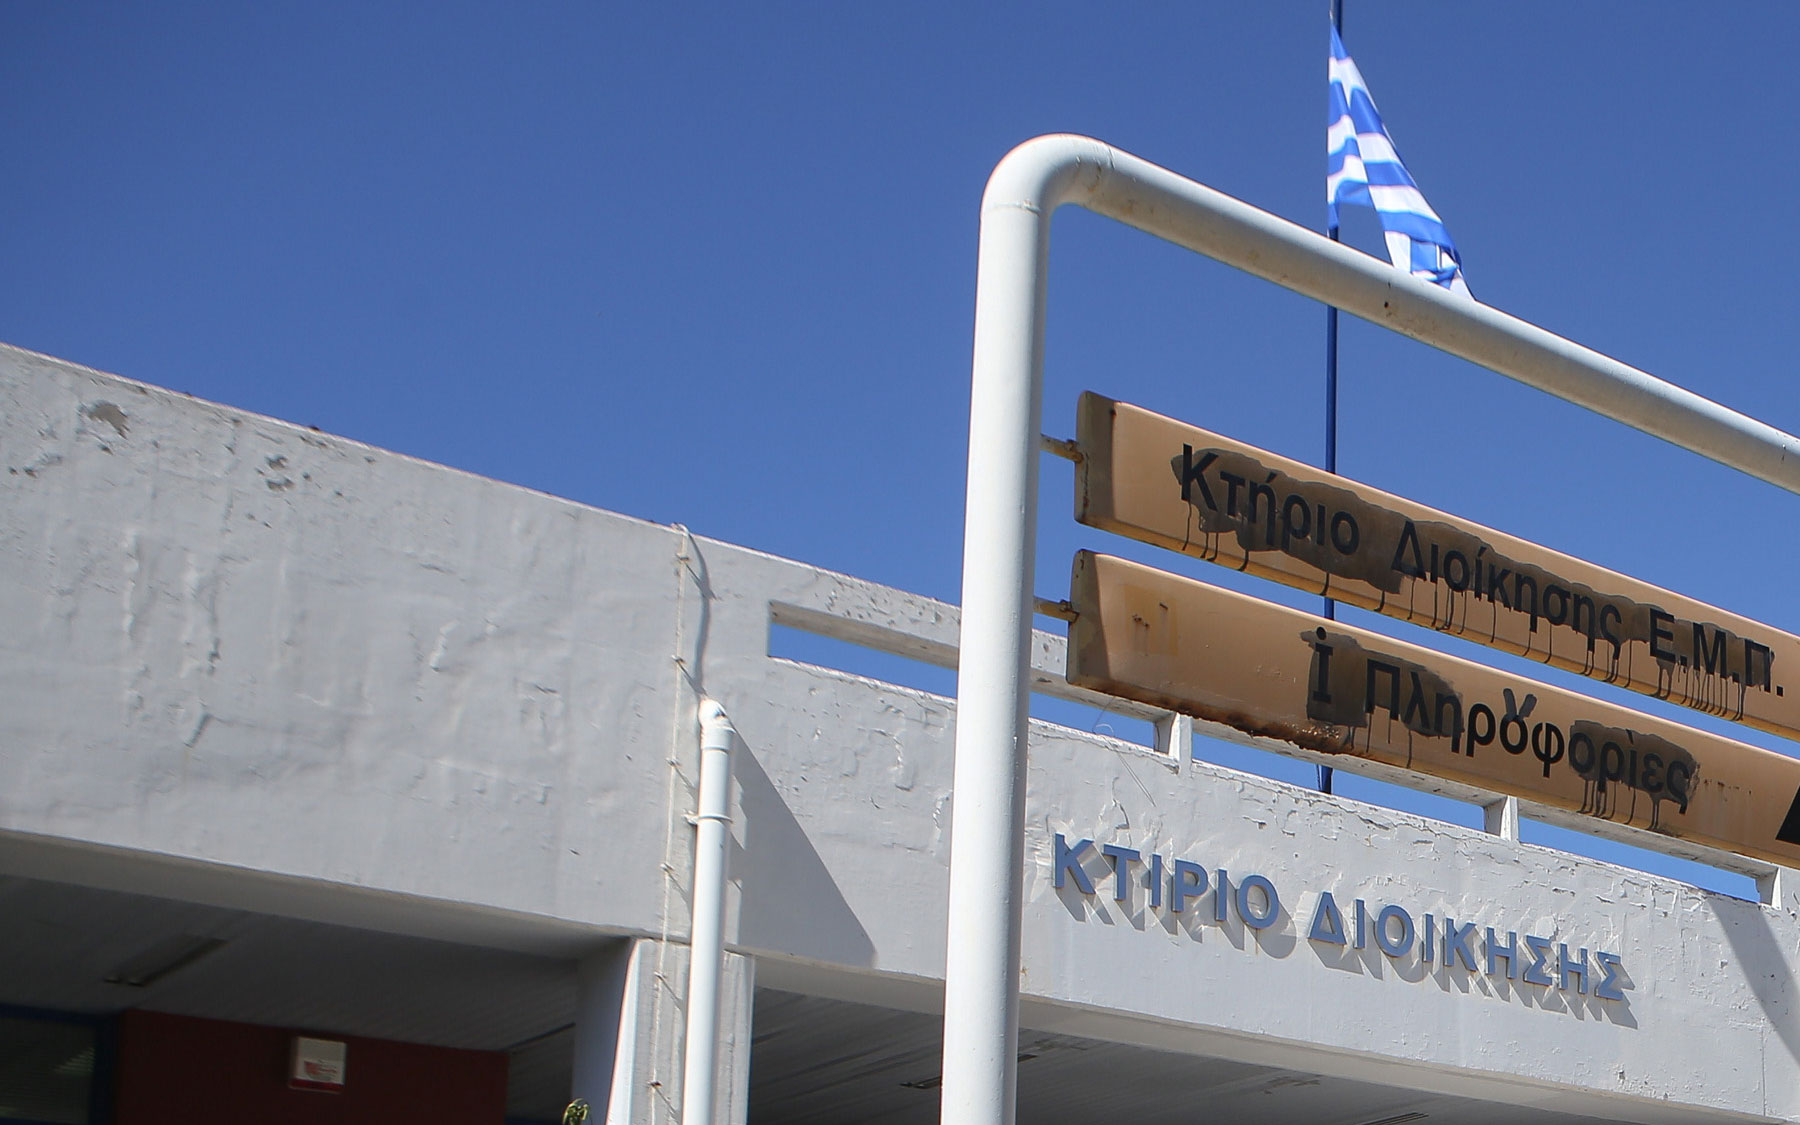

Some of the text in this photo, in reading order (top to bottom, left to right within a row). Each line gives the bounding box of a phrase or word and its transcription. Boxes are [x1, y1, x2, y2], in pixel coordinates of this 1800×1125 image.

[1180, 442, 1785, 698] Κτήριο Διοίκησης Ε.Μ.Π.
[1054, 832, 1623, 1001] ΚΤΙΡΙΟ ΔΙΟΙΚΗΣΗΣ
